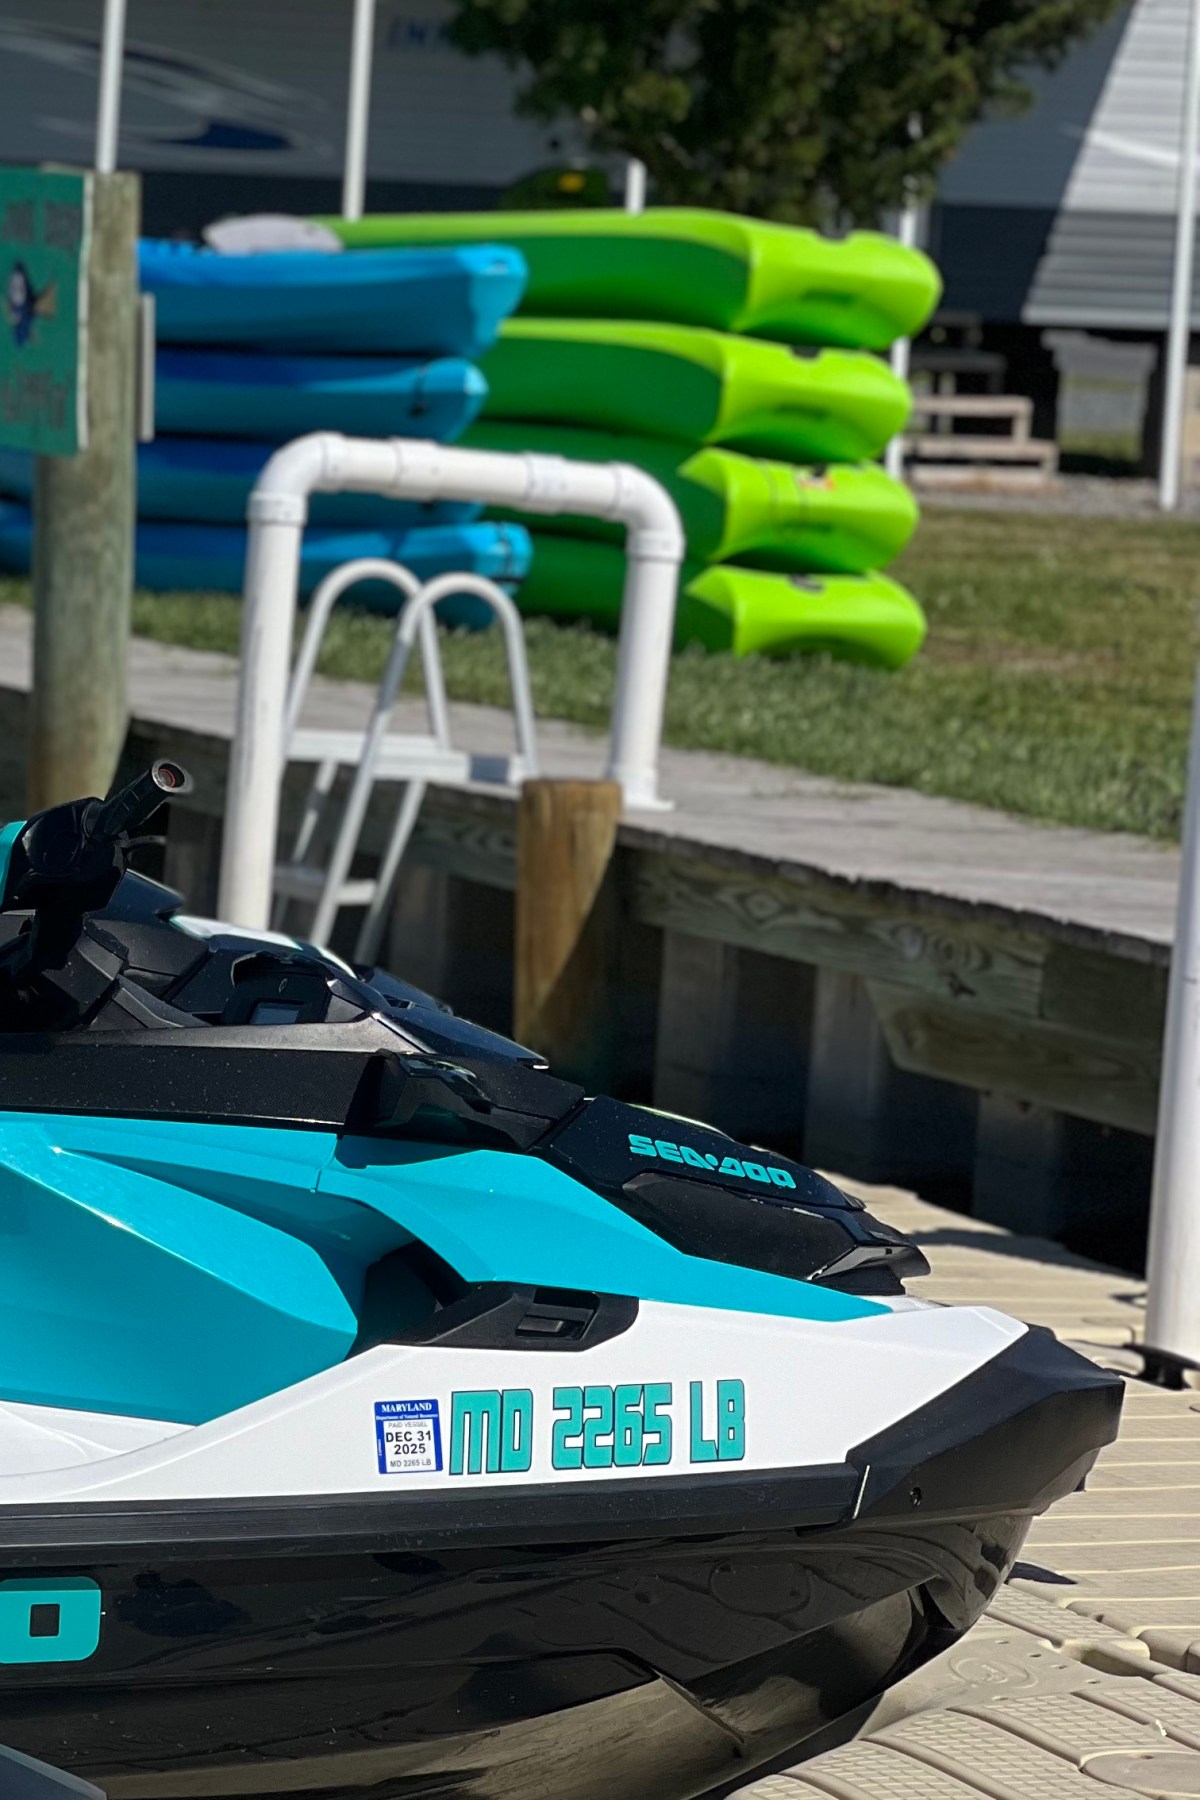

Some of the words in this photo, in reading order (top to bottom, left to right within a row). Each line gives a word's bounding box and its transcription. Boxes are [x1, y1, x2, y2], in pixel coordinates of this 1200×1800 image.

[381, 1402, 432, 1413] MARYLAND
[449, 1388, 533, 1475] MD
[552, 1382, 672, 1470] 2265
[690, 1379, 745, 1464] LB
[386, 1431, 412, 1442] DEC
[417, 1430, 431, 1441] 31
[394, 1443, 426, 1455] 2025
[403, 1459, 420, 1467] 2265
[422, 1458, 431, 1466] LB
